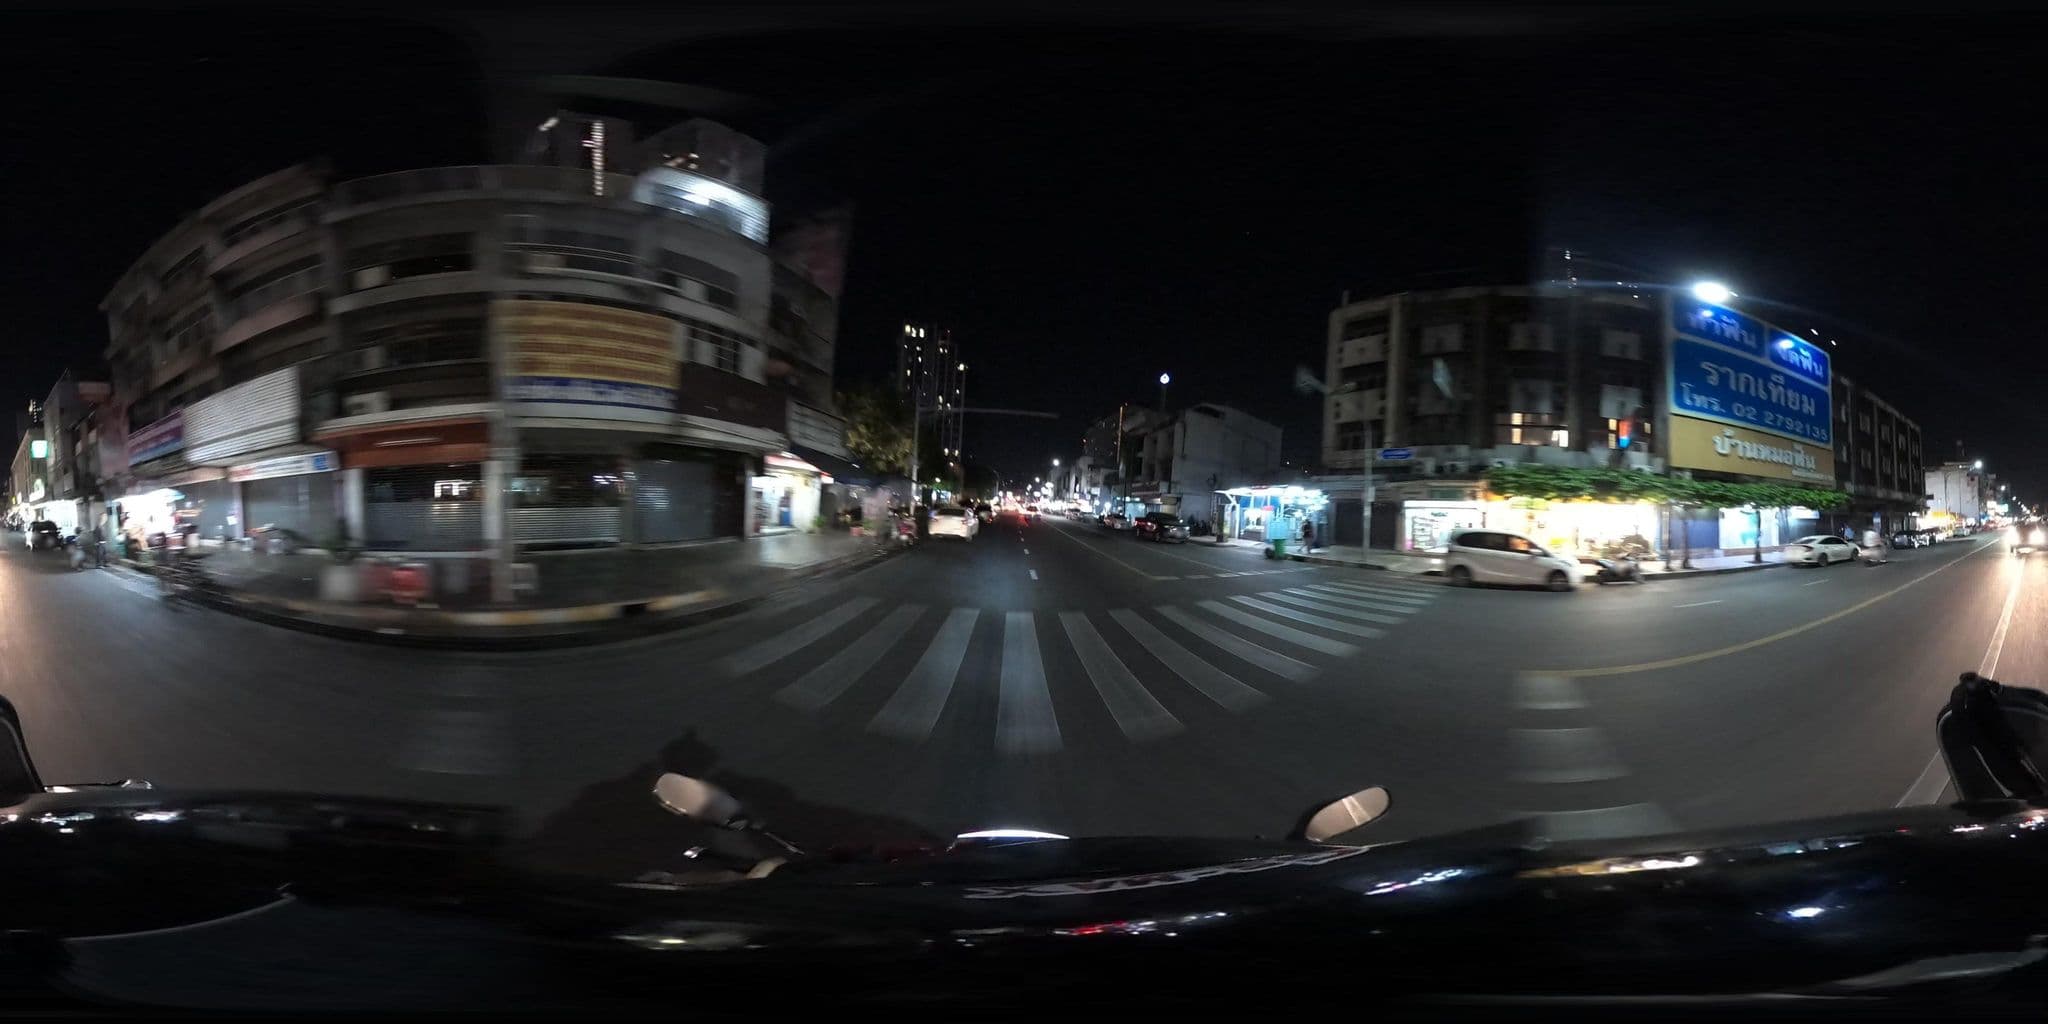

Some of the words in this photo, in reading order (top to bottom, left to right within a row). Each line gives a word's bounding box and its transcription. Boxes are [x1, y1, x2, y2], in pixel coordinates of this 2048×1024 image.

[1778, 346, 1824, 377] จดฟัน
[1701, 361, 1815, 416] รากเทียม
[1732, 402, 1759, 420] 02
[1763, 410, 1828, 440] 2792135
